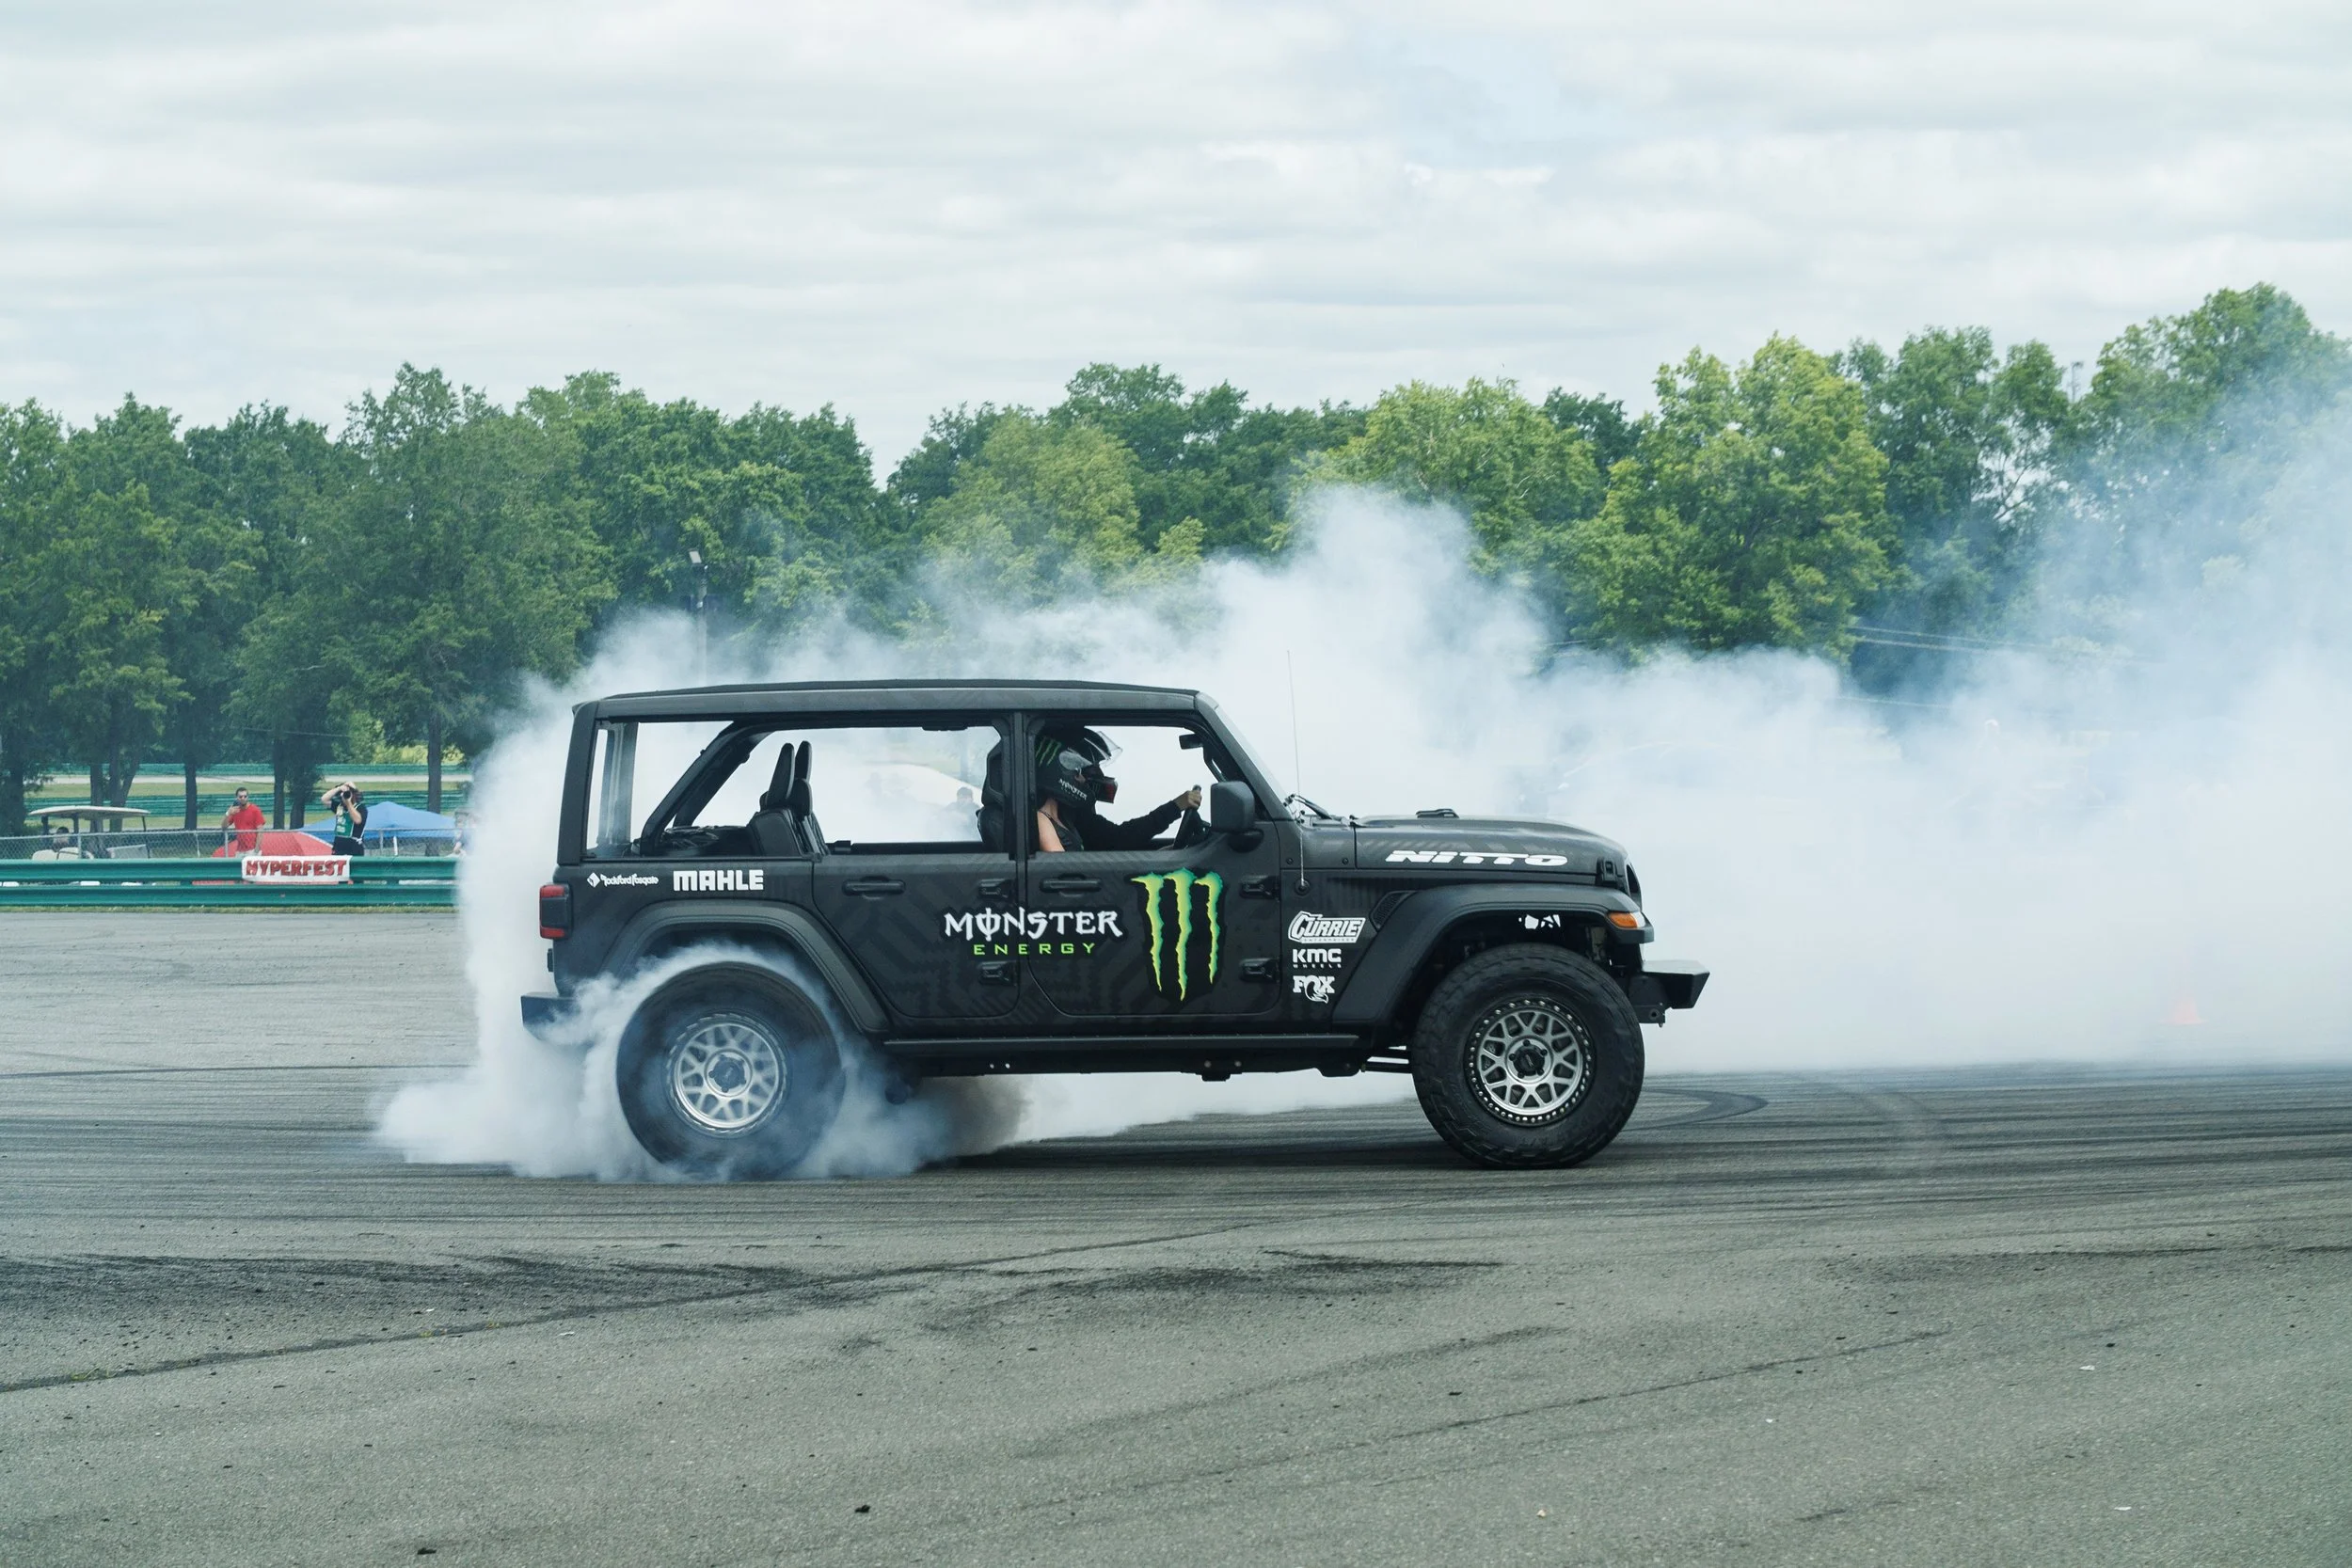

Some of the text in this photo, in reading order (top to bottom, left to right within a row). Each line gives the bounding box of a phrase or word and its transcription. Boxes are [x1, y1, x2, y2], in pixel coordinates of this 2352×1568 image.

[1385, 849, 1568, 866] NITTO
[246, 860, 347, 876] HYPERFEST
[673, 869, 764, 891] MAHLE
[944, 907, 1123, 942] MONSTER
[1291, 913, 1361, 940] CURRIE
[973, 942, 1096, 956] ENERGY
[1292, 948, 1342, 963] KMC
[1292, 974, 1336, 1004] FOX
